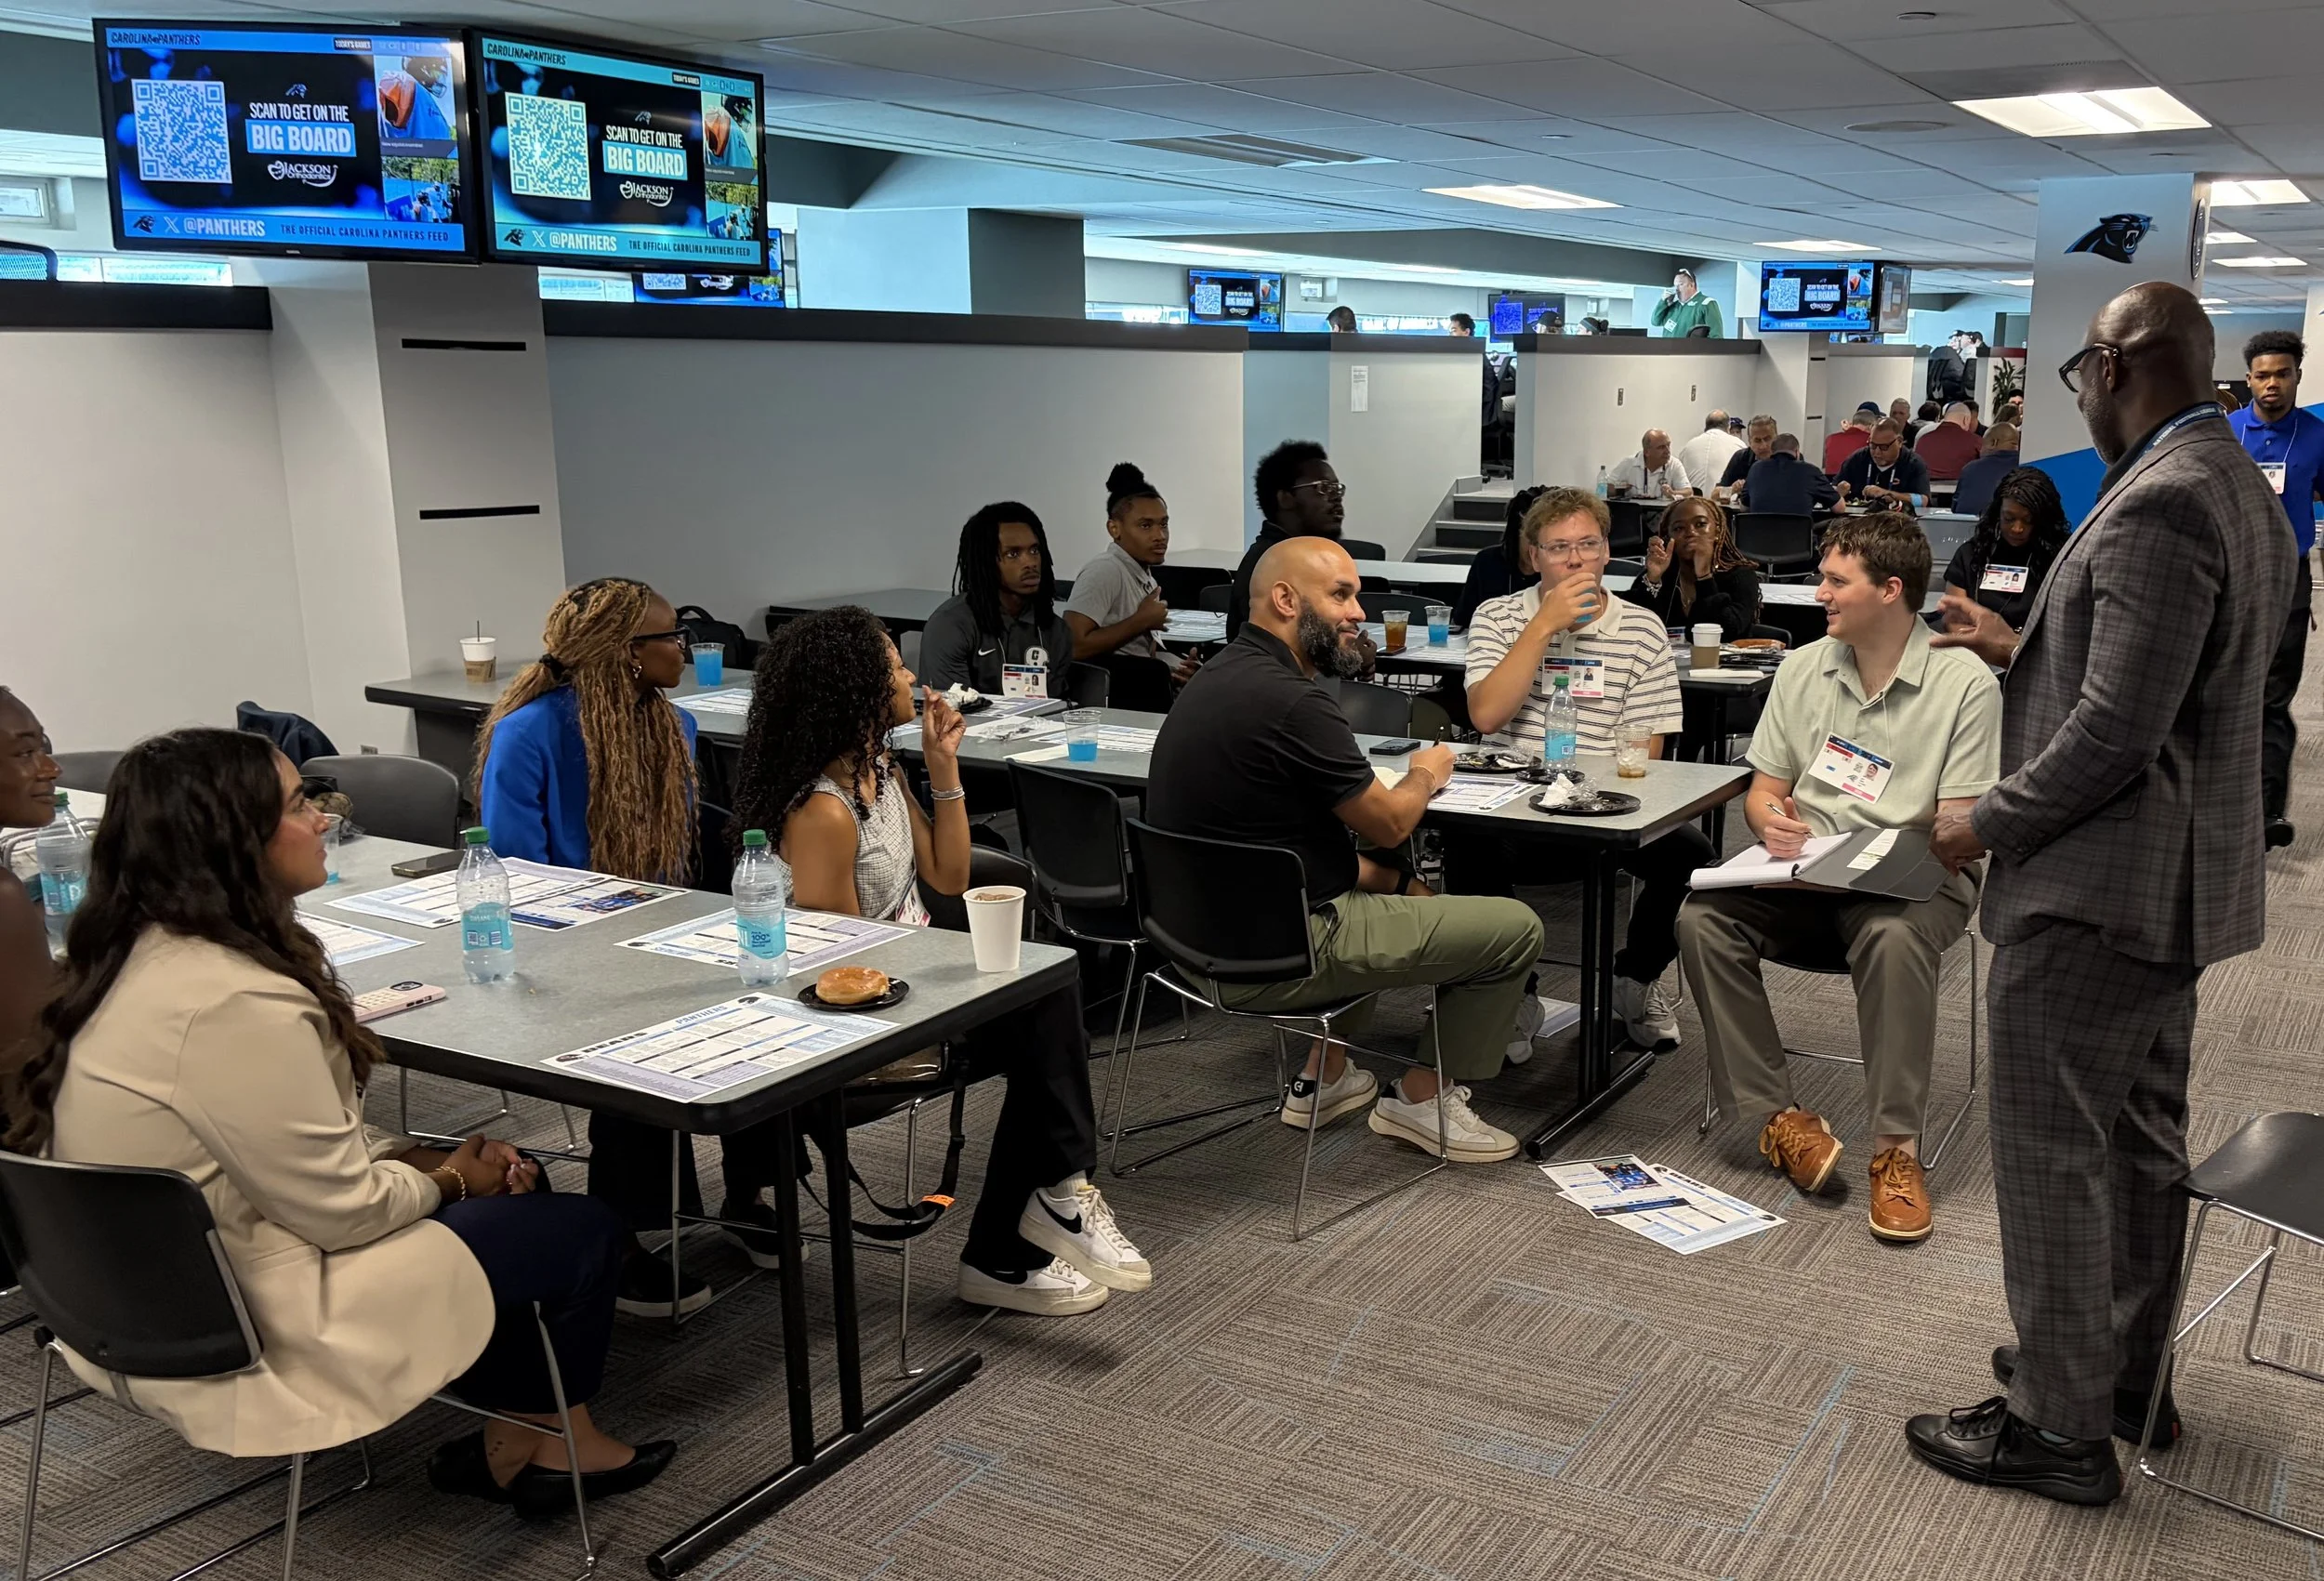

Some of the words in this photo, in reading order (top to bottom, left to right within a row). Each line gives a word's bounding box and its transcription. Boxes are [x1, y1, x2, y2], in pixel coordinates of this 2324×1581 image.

[111, 32, 152, 44] CAROLINA
[157, 33, 201, 46] PANTHERS
[487, 43, 524, 59] CAROLINA
[528, 50, 566, 65] PANTHERS
[249, 102, 277, 119] SCAN
[278, 103, 291, 120] TO
[293, 103, 311, 121] GET
[313, 104, 328, 122] ON
[329, 105, 350, 122] THE
[251, 124, 284, 151] BIG
[287, 125, 352, 153] BOARD
[606, 125, 628, 142] SCAN
[628, 127, 640, 143] TO
[640, 129, 654, 145] GET
[655, 131, 667, 147] ON
[667, 132, 683, 149] THE
[284, 162, 331, 175] JACKSON
[607, 145, 633, 172] BIG
[636, 149, 684, 177] BOARD
[632, 182, 668, 195] JACKSON
[183, 217, 266, 237] @PANTHERS
[281, 224, 296, 234] THE
[298, 225, 336, 237] OFFICIAL
[338, 228, 380, 239] CAROLINA
[382, 229, 425, 241] PANTHERS
[428, 231, 449, 242] FEED
[549, 231, 617, 252] @PANTHERS
[628, 240, 640, 250] THE
[642, 241, 671, 252] OFFICIAL
[673, 244, 703, 254] CAROLINA
[705, 245, 734, 256] PANTHERS
[735, 247, 751, 257] FEED
[675, 1005, 729, 1024] PANTHERS
